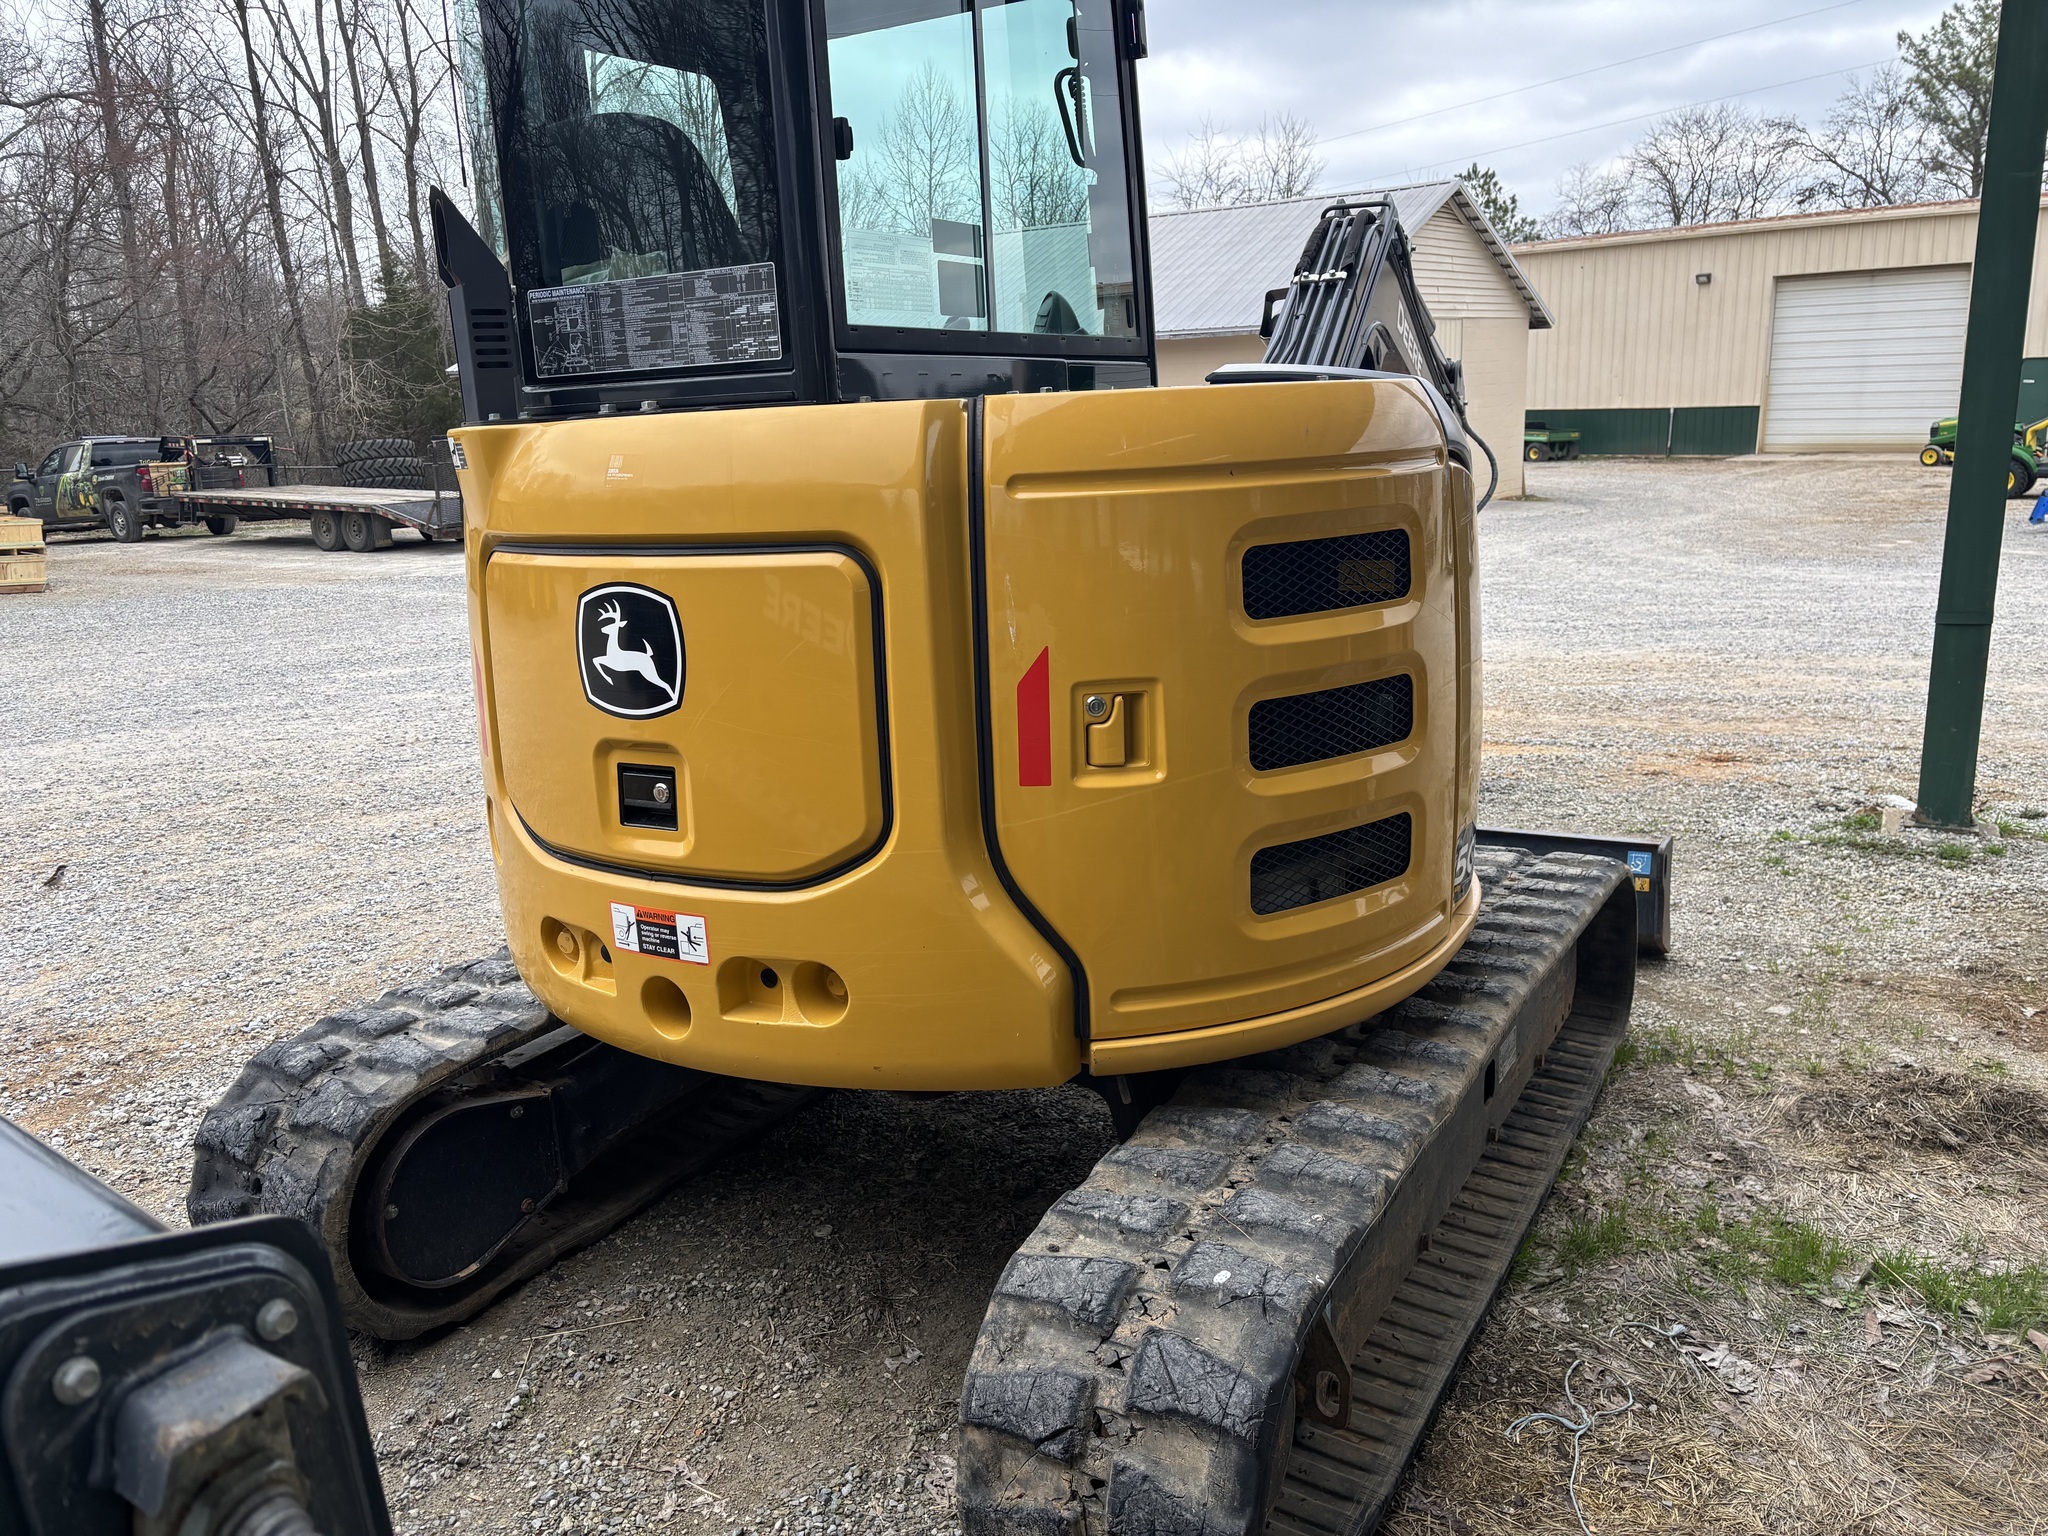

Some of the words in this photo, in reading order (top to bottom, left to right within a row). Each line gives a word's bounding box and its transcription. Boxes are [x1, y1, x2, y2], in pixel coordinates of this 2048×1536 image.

[529, 290, 551, 299] PERIODIC
[551, 286, 586, 297] MAINTENANCE
[1397, 299, 1423, 377] DEERE
[642, 911, 676, 923] WARNING
[640, 923, 660, 932] Operator
[659, 927, 670, 935] may
[641, 930, 654, 938] swing
[659, 933, 677, 941] reverse
[641, 936, 660, 944] machine
[642, 943, 656, 951] STAY
[656, 945, 676, 955] CLEAR
